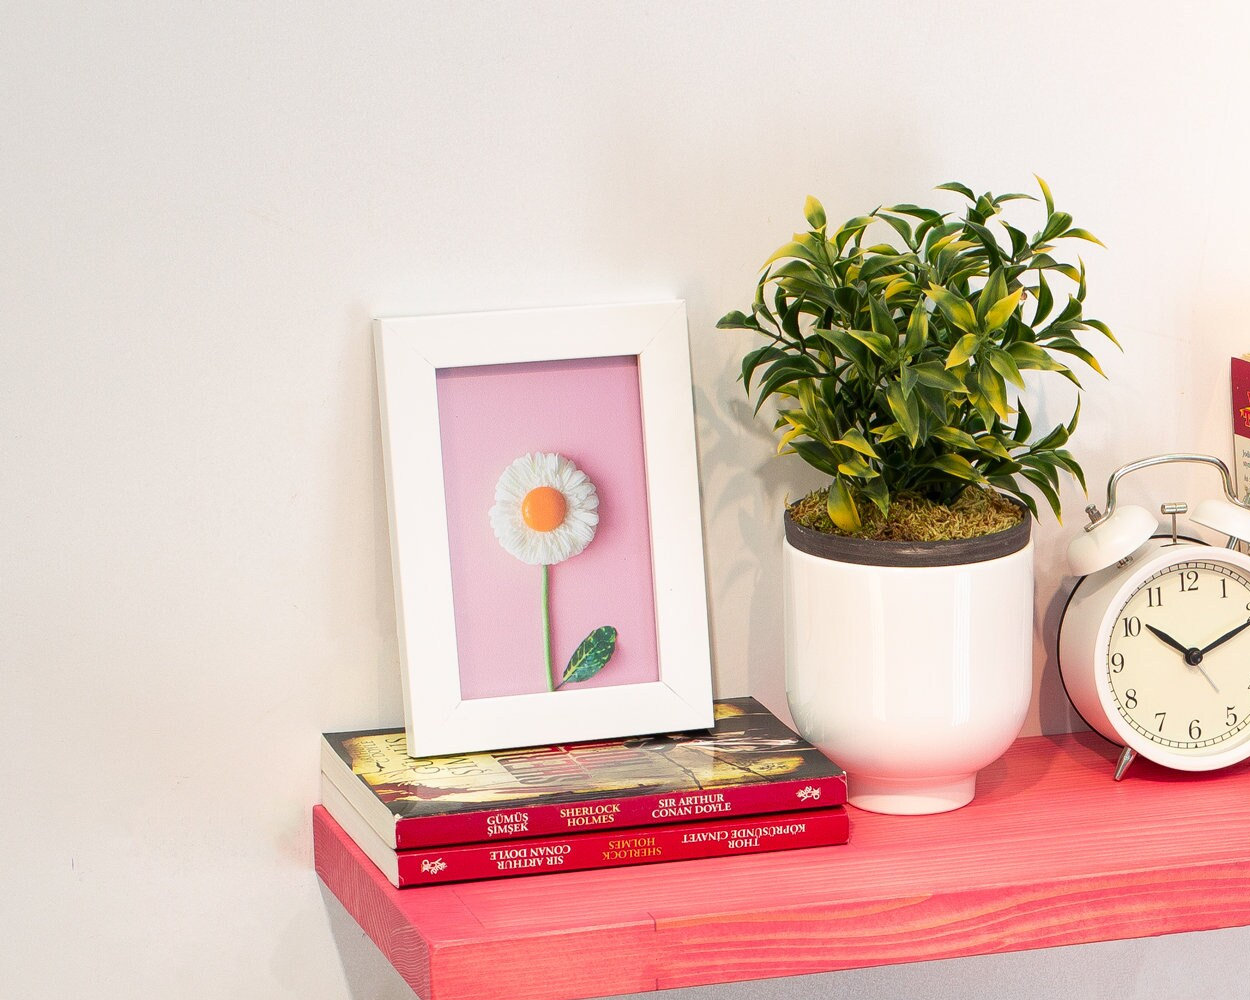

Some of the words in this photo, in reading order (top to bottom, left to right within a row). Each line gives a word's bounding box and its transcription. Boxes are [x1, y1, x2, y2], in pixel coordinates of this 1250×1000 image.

[1178, 570, 1199, 592] 12
[1220, 578, 1228, 598] 1
[1147, 586, 1163, 608] 11
[1123, 616, 1141, 638] 10
[1111, 652, 1125, 674] 9
[1125, 688, 1138, 710] 8
[1155, 712, 1167, 732] 7
[1225, 705, 1238, 727] 5
[1188, 719, 1201, 740] 6
[658, 798, 677, 808] SIR
[678, 793, 725, 807] ARTHUR
[560, 803, 621, 818] SHERLOCK
[651, 806, 694, 819] CONAN
[695, 802, 731, 814] DOYLE
[486, 812, 529, 826] GÜMÜŞ
[567, 814, 615, 827] HOLMES
[487, 822, 529, 837] ŞİMŞEK
[681, 830, 729, 844] CİNAYET
[730, 823, 806, 840] KÖPRÜSÜNDE
[529, 844, 571, 857] CONAN
[608, 837, 656, 850] HOLMES
[728, 838, 760, 849] THOR
[489, 848, 527, 861] DOYLE
[546, 856, 564, 866] SIR
[602, 846, 662, 861] SHERLOCK
[497, 857, 544, 870] ARTHUR
